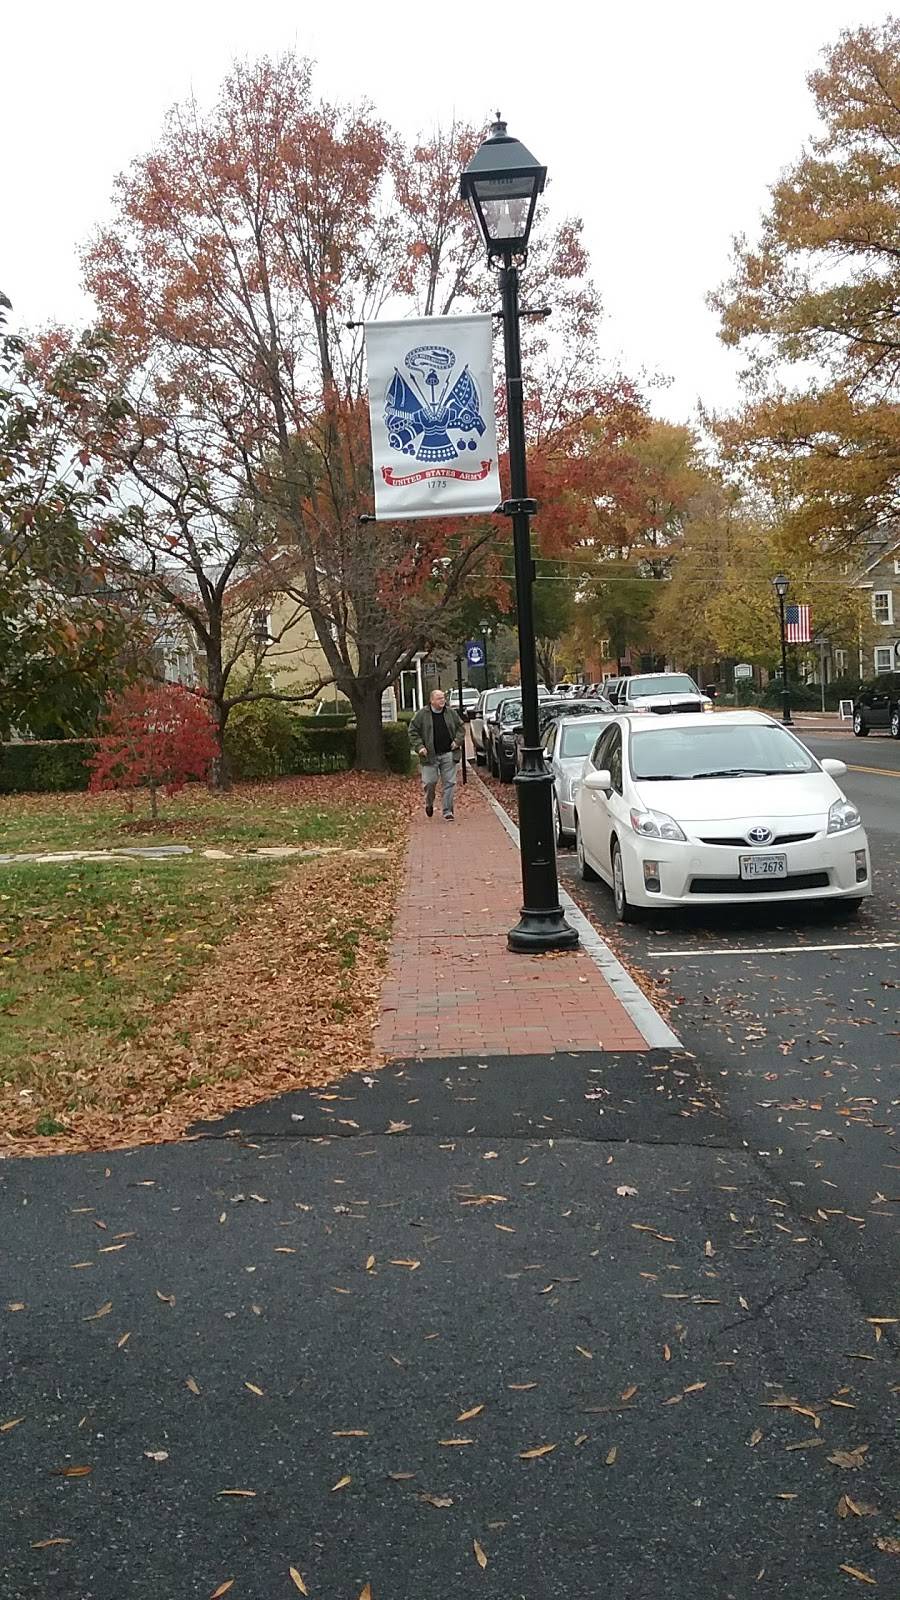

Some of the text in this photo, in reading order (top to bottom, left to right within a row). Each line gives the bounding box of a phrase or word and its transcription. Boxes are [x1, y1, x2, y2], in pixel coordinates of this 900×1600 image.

[392, 475, 422, 486] UNITED
[425, 470, 456, 478] STATES
[427, 480, 447, 489] 1775
